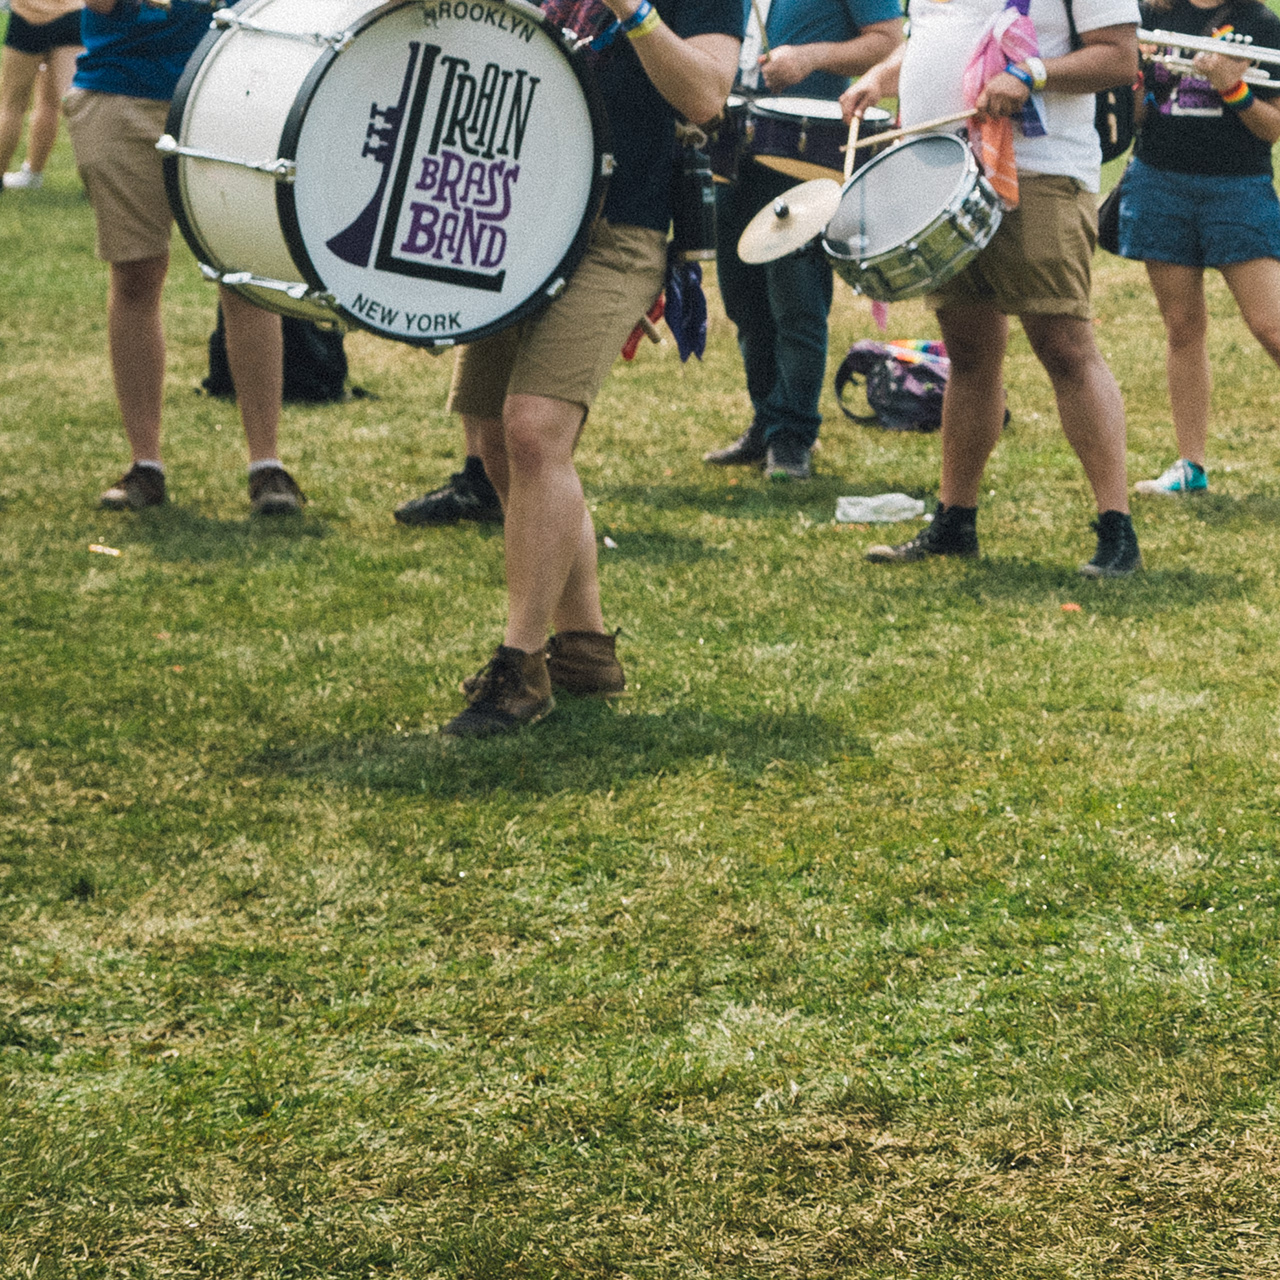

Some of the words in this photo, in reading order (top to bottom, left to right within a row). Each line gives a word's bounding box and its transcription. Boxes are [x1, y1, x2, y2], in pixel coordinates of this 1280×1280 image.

[428, 55, 541, 160] TRAIN
[415, 150, 520, 221] BRASS
[400, 201, 507, 268] BAND
[351, 292, 399, 326] NEW
[405, 311, 462, 333] YORK
